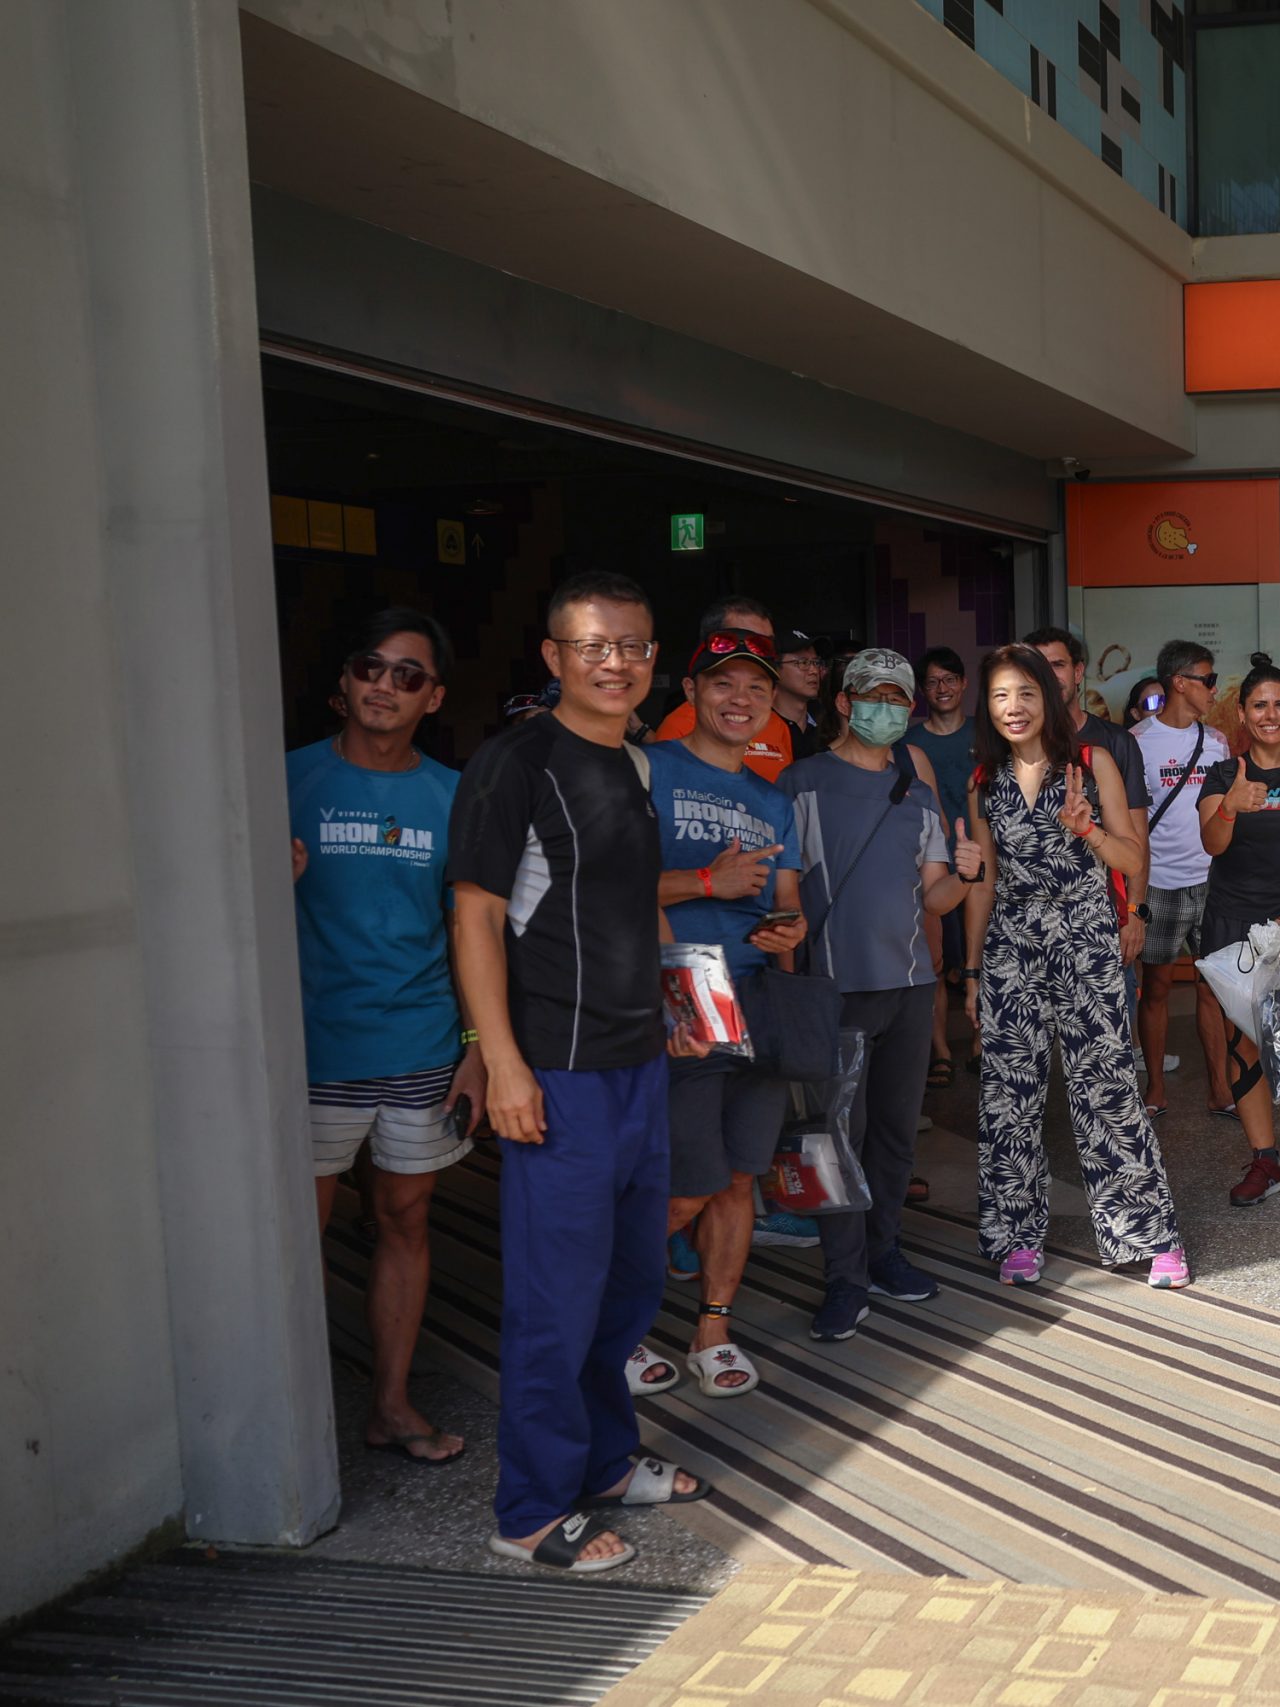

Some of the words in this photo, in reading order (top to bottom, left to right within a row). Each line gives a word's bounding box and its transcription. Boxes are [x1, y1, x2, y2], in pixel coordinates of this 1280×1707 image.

[687, 789, 732, 807] MaiCoin
[337, 810, 379, 819] VINFAST
[673, 799, 776, 843] IRONMAN
[674, 820, 722, 843] 70.3
[320, 844, 357, 855] WORLD
[359, 845, 431, 861] CHAMPIONSHIP
